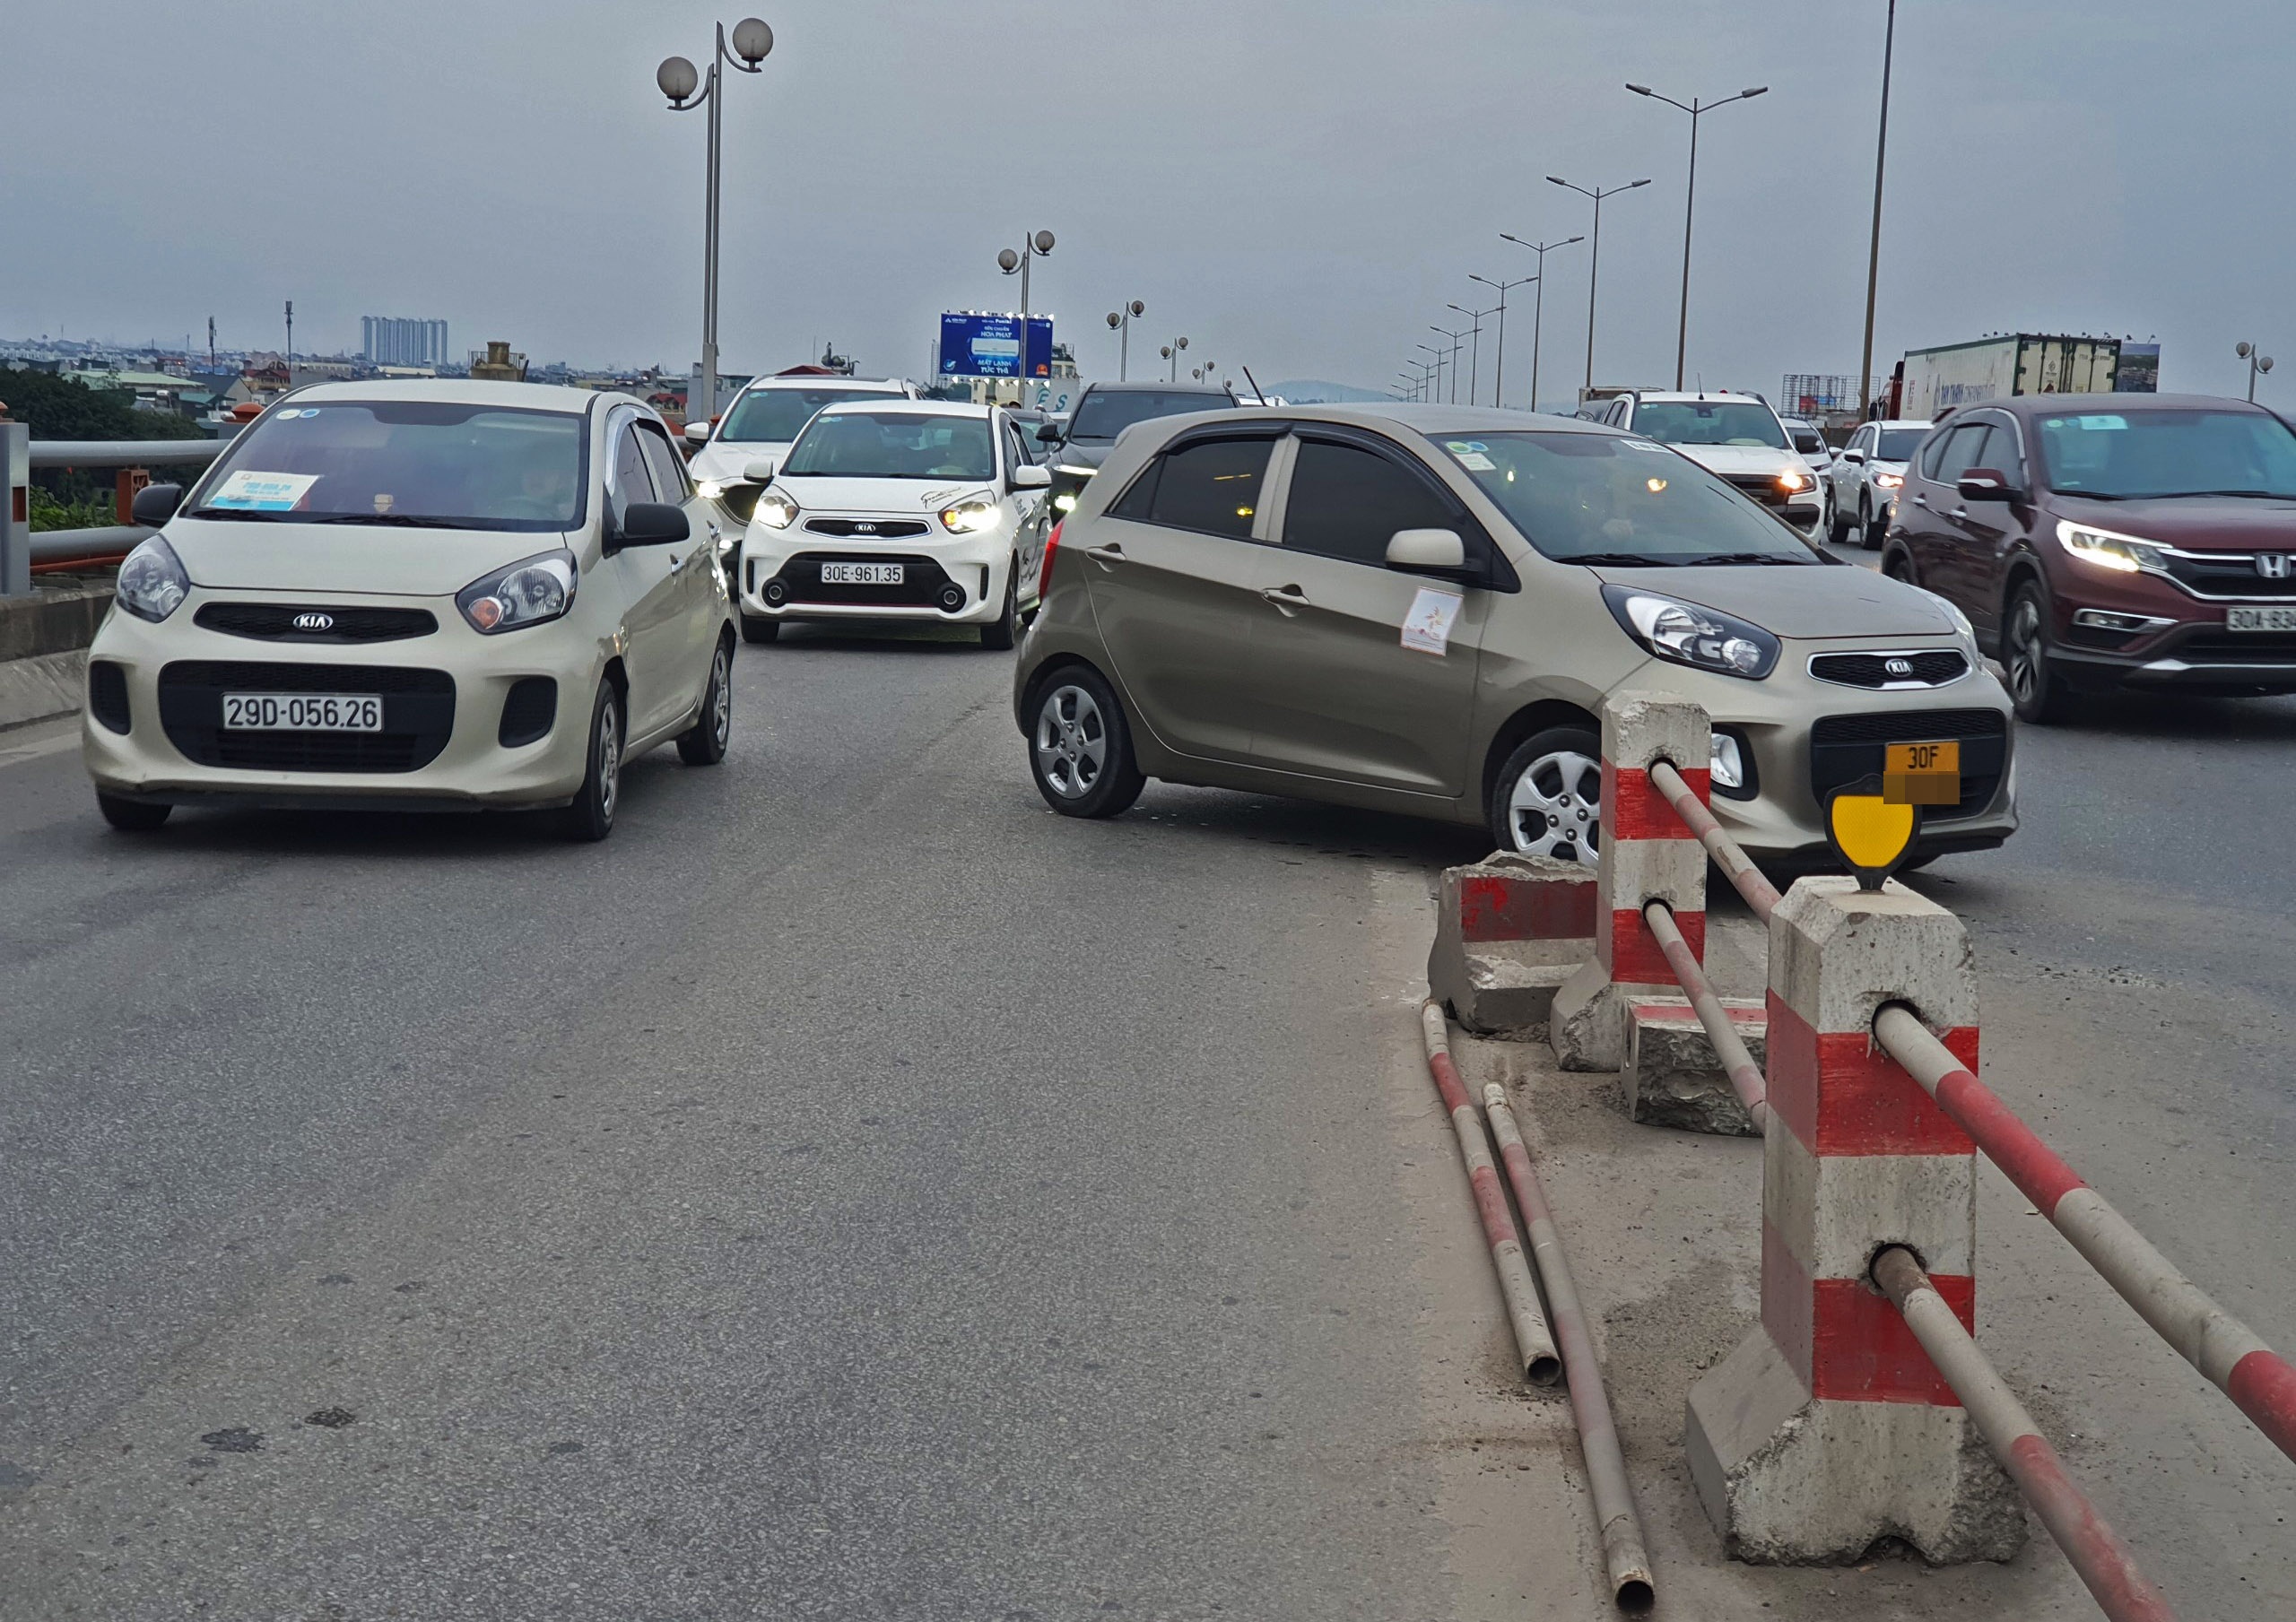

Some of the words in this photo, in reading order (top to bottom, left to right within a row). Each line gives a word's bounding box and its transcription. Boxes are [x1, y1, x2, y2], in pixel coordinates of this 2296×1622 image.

[823, 566, 901, 582] 30E-961.35
[299, 615, 326, 628] KIA
[1890, 661, 1911, 673] KIA
[227, 698, 378, 728] 29D-056.26
[1908, 745, 1939, 769] 30F
